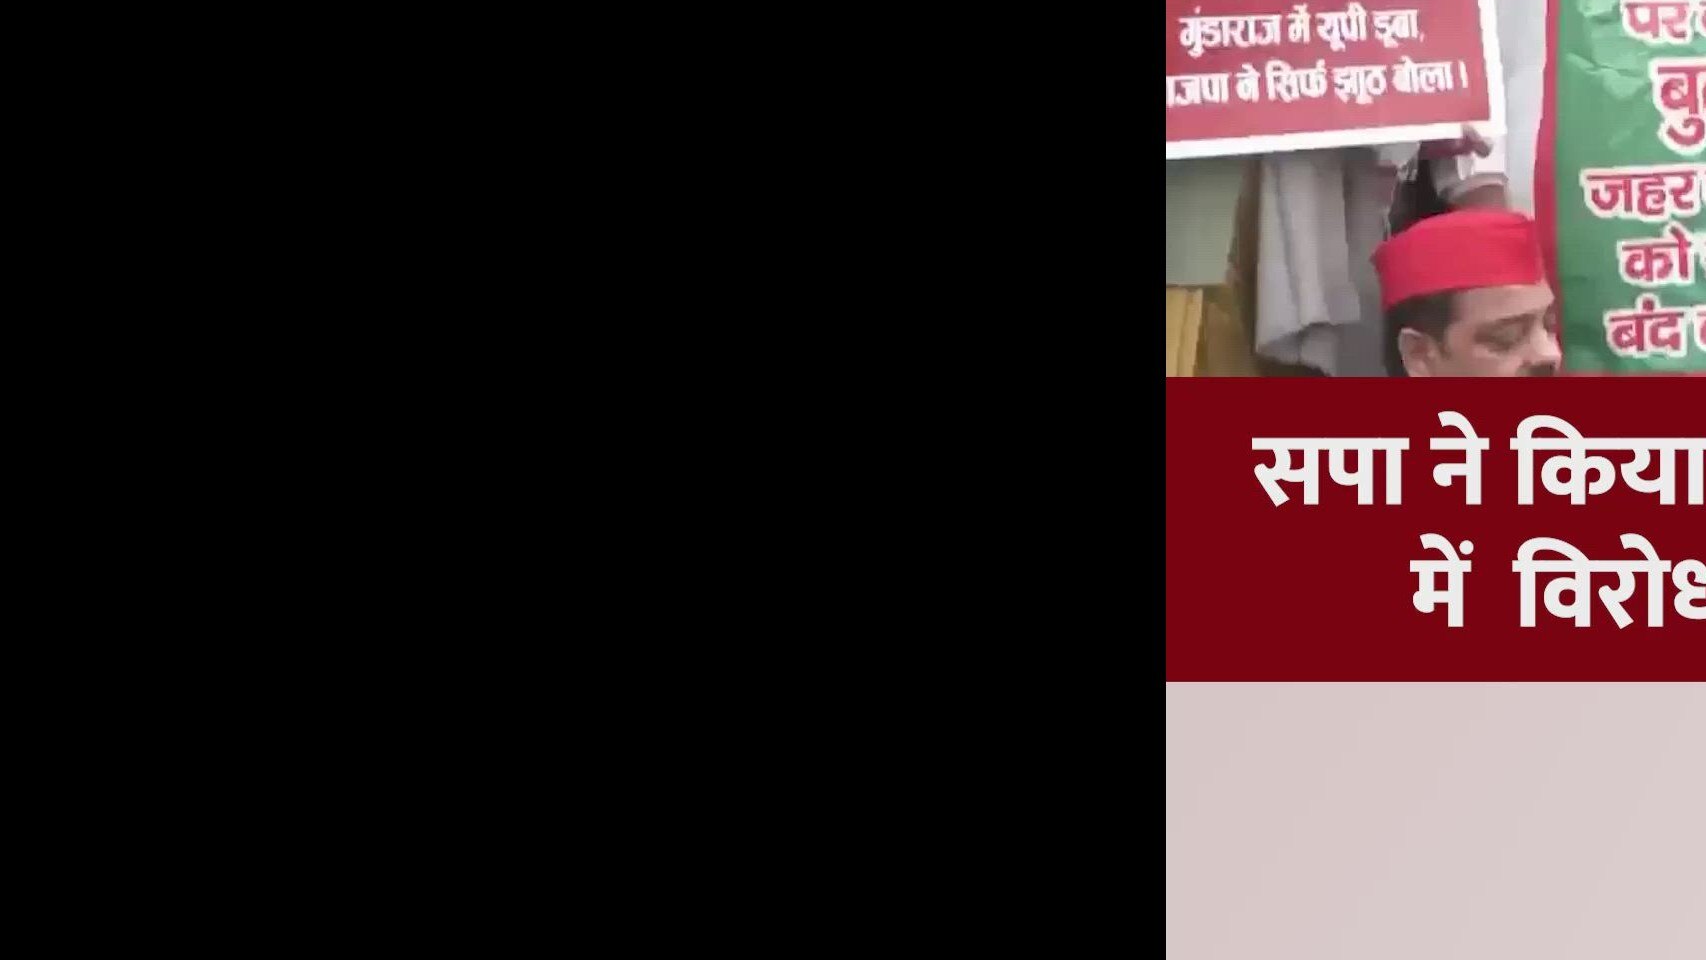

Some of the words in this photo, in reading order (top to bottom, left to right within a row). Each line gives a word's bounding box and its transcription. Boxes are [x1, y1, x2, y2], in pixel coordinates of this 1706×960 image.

[1286, 3, 1310, 44] में
[1316, 2, 1367, 52] यूपी
[1624, 1, 1689, 39] पर
[1235, 63, 1260, 102] ने
[1266, 58, 1327, 103] सिर्फ
[1332, 65, 1387, 105] झूठ
[1587, 170, 1698, 216] जहर
[1622, 227, 1691, 281] को
[1610, 296, 1684, 351] बंद
